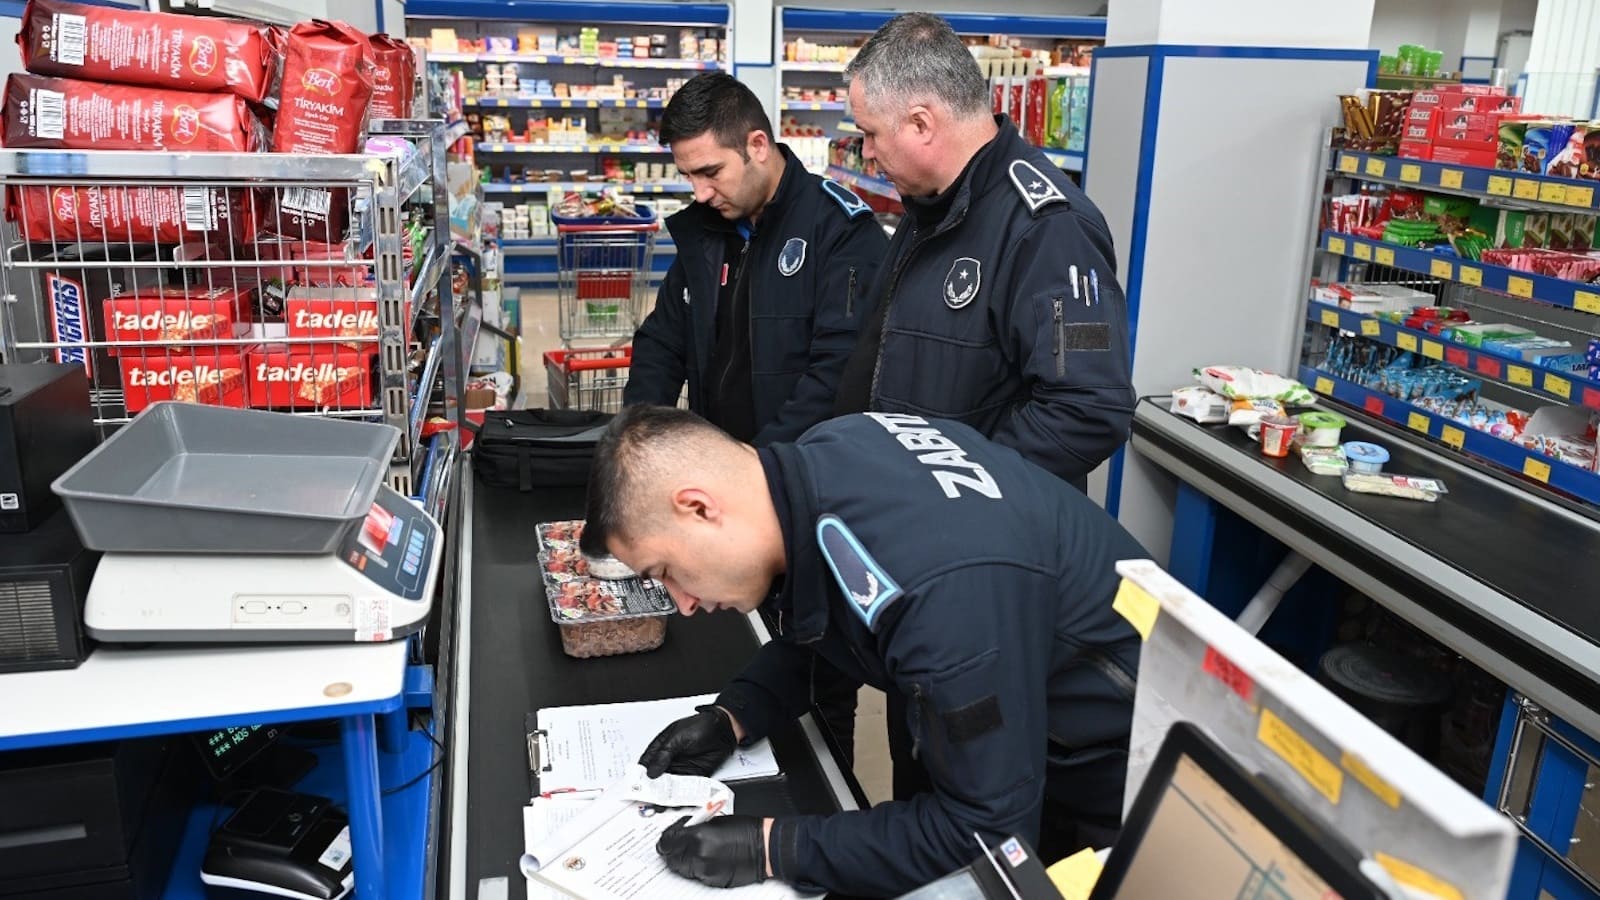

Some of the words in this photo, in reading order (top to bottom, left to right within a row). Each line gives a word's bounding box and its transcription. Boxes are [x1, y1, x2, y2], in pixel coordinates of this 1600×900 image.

[293, 96, 345, 117] TİRYAKİM
[111, 310, 209, 331] tadelle
[128, 365, 224, 387] tadelle
[256, 362, 349, 383] tadelle
